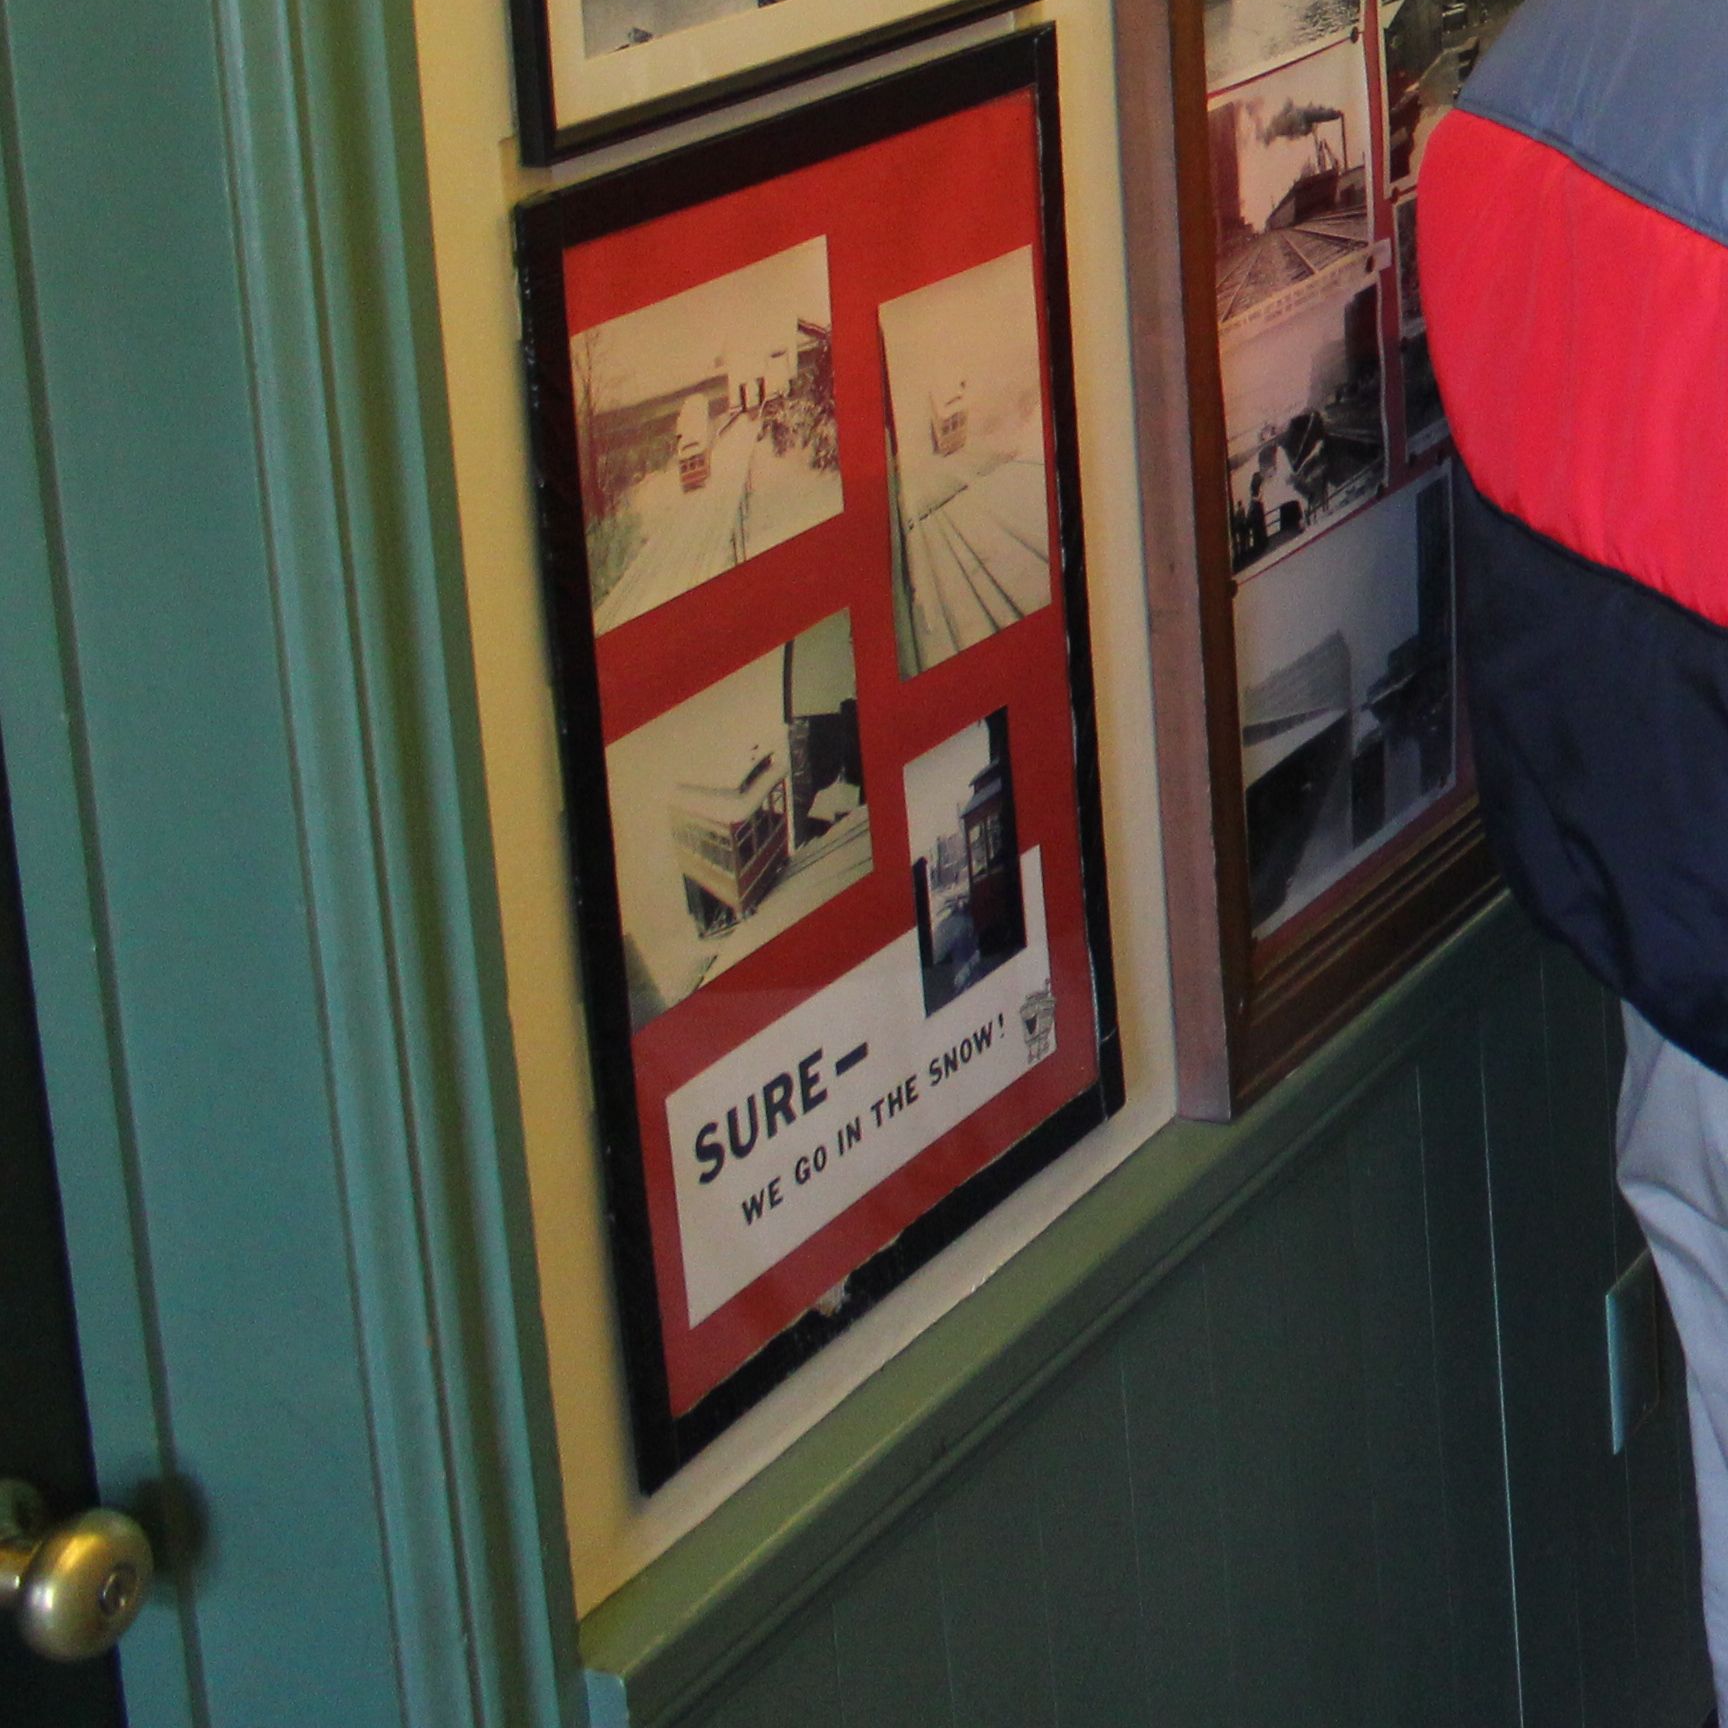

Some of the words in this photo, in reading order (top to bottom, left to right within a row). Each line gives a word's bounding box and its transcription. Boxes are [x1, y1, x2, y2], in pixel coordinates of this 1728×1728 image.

[742, 1176, 784, 1226] WE
[795, 1145, 828, 1186] GO
[838, 1116, 863, 1156] IN
[870, 1074, 920, 1128] THE
[929, 1013, 1005, 1087] SNOW!
